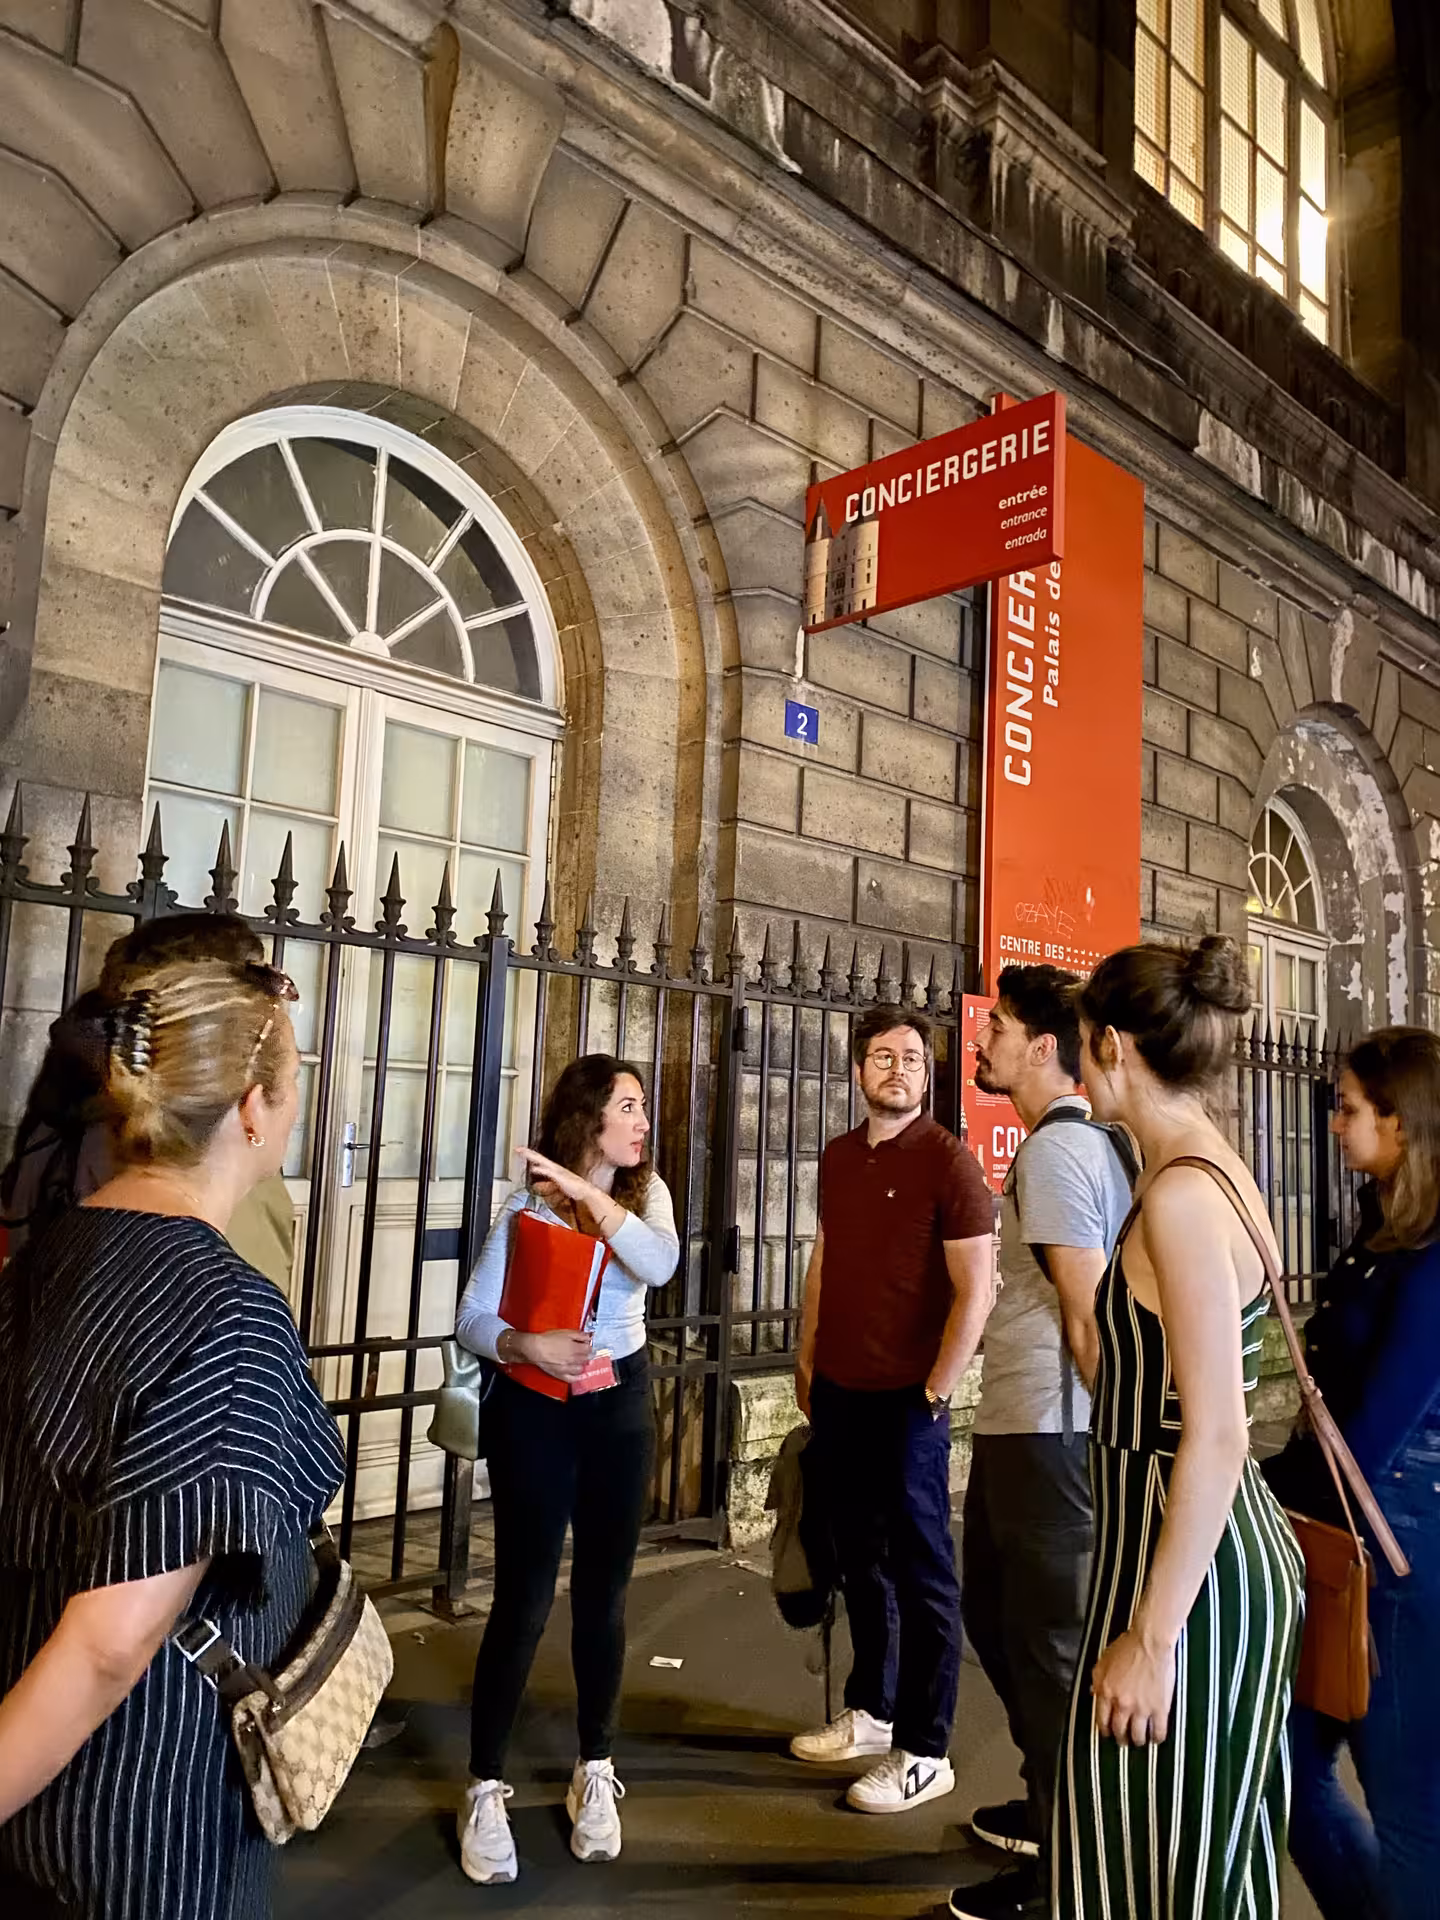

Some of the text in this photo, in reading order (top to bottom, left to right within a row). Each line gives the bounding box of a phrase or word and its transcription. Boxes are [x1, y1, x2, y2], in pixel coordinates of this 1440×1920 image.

[845, 420, 1050, 523] CONCIERGERIE
[998, 484, 1048, 510] entrée
[1000, 507, 1047, 530] entrance
[1005, 527, 1047, 550] entrada
[1043, 561, 1061, 708] Palais de
[796, 712, 808, 736] 2
[999, 934, 1065, 960] CENTRE DES
